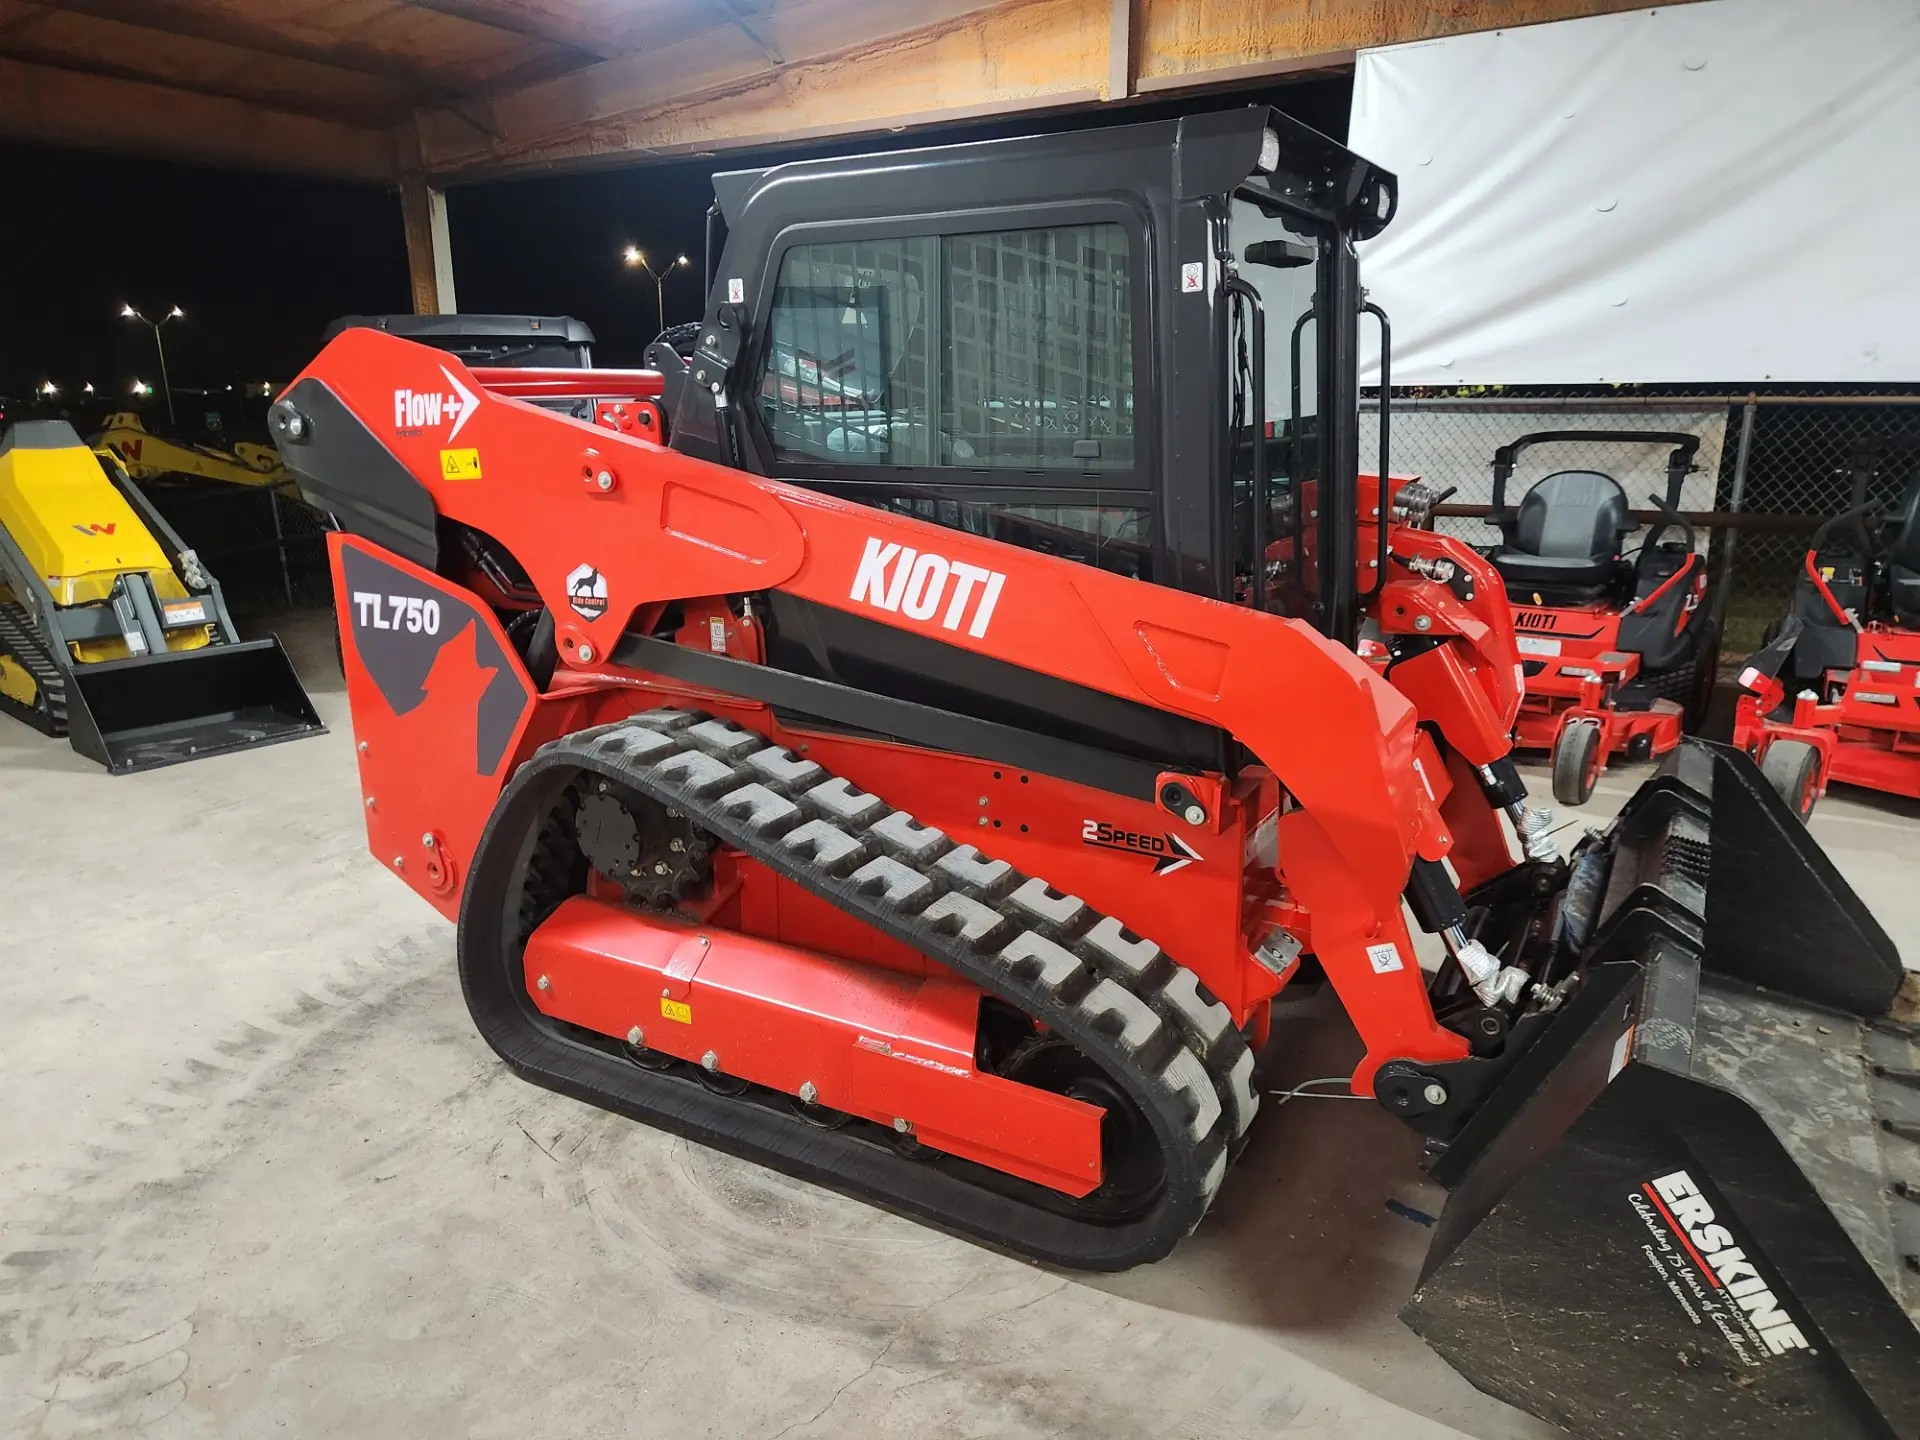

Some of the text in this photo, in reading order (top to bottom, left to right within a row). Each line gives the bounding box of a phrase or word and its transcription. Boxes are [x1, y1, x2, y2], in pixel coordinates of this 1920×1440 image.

[394, 389, 463, 428] Flow+
[585, 598, 605, 606] Control
[849, 536, 1006, 639] KIOTI
[353, 591, 440, 635] TL750
[1514, 611, 1558, 630] KIOTI
[1627, 1192, 1673, 1254] Celebrating
[1666, 1251, 1686, 1271] 75
[1677, 1267, 1705, 1300] Years
[1702, 1299, 1721, 1314] of
[1652, 1170, 1810, 1355] ERSKINE
[1667, 1280, 1702, 1325] Minnesota
[1716, 1288, 1772, 1358] ATTACHMENTS
